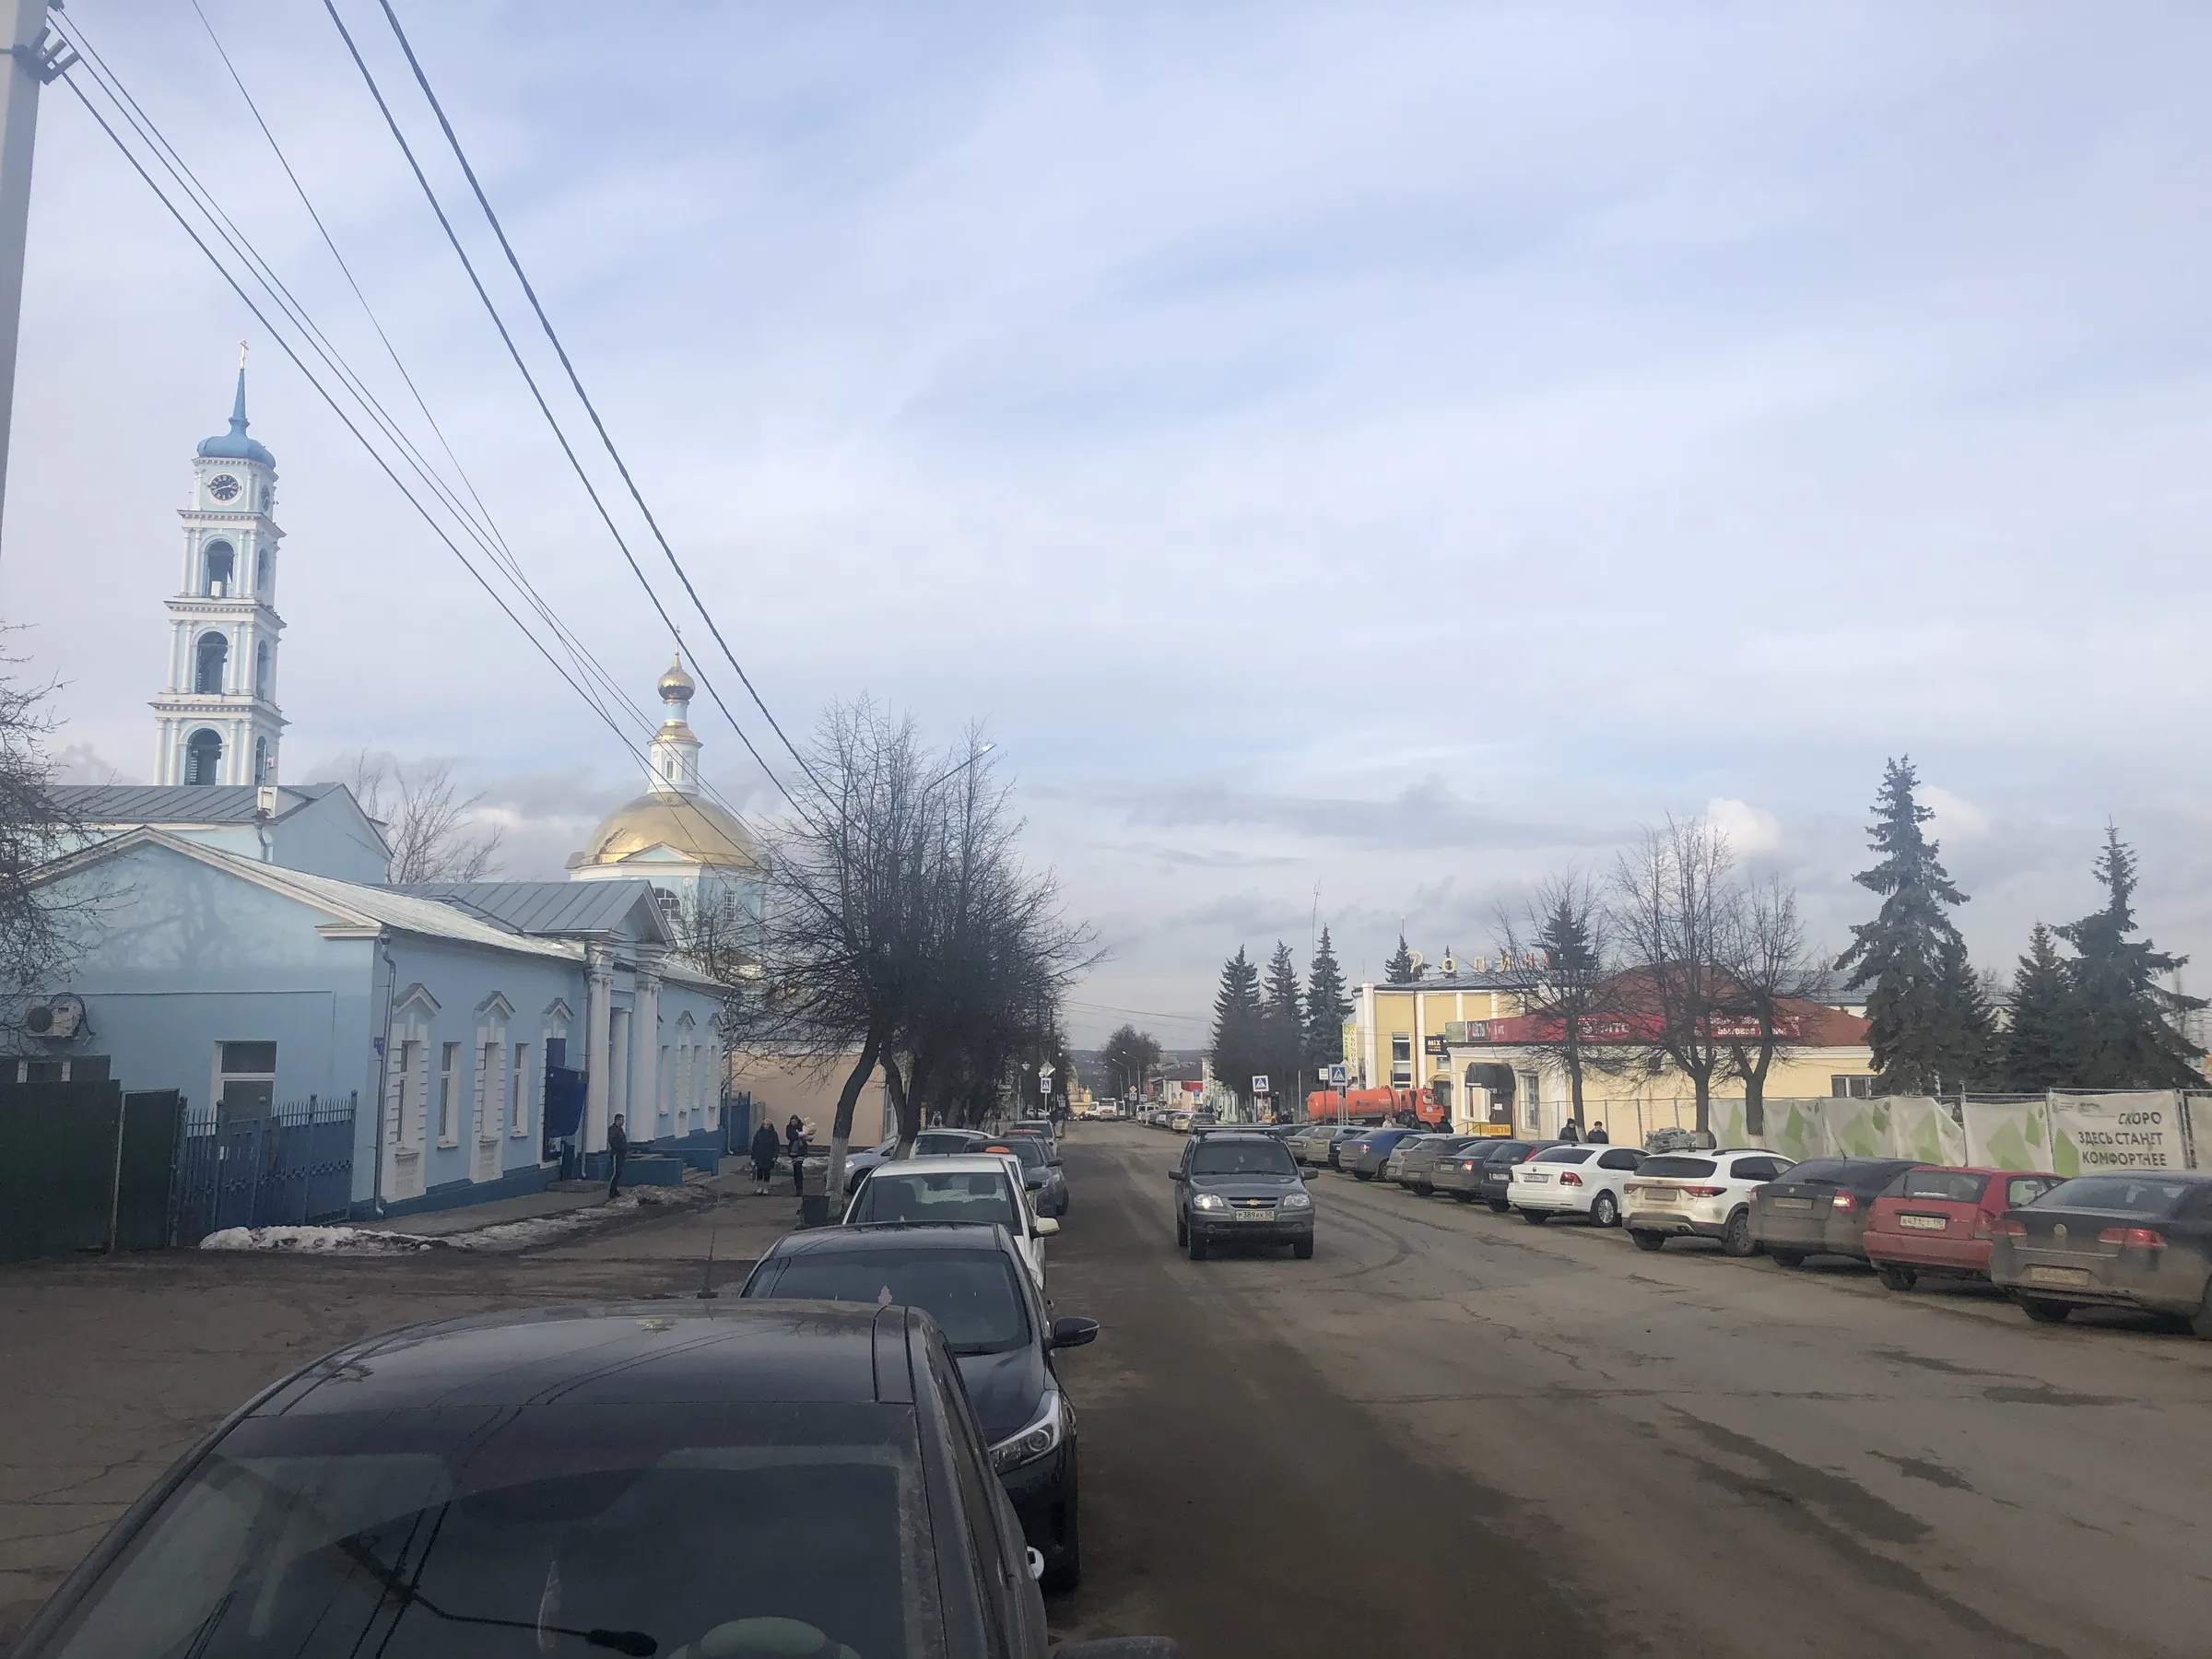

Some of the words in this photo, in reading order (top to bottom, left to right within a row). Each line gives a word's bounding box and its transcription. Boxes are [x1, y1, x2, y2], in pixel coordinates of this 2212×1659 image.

[2118, 1112, 2162, 1124] СКОРО
[2078, 1131, 2112, 1146] ЗДЕСЬ
[2115, 1132, 2163, 1146] СТАНЕТ
[2082, 1151, 2167, 1167] КОМФОРТНЕЕ
